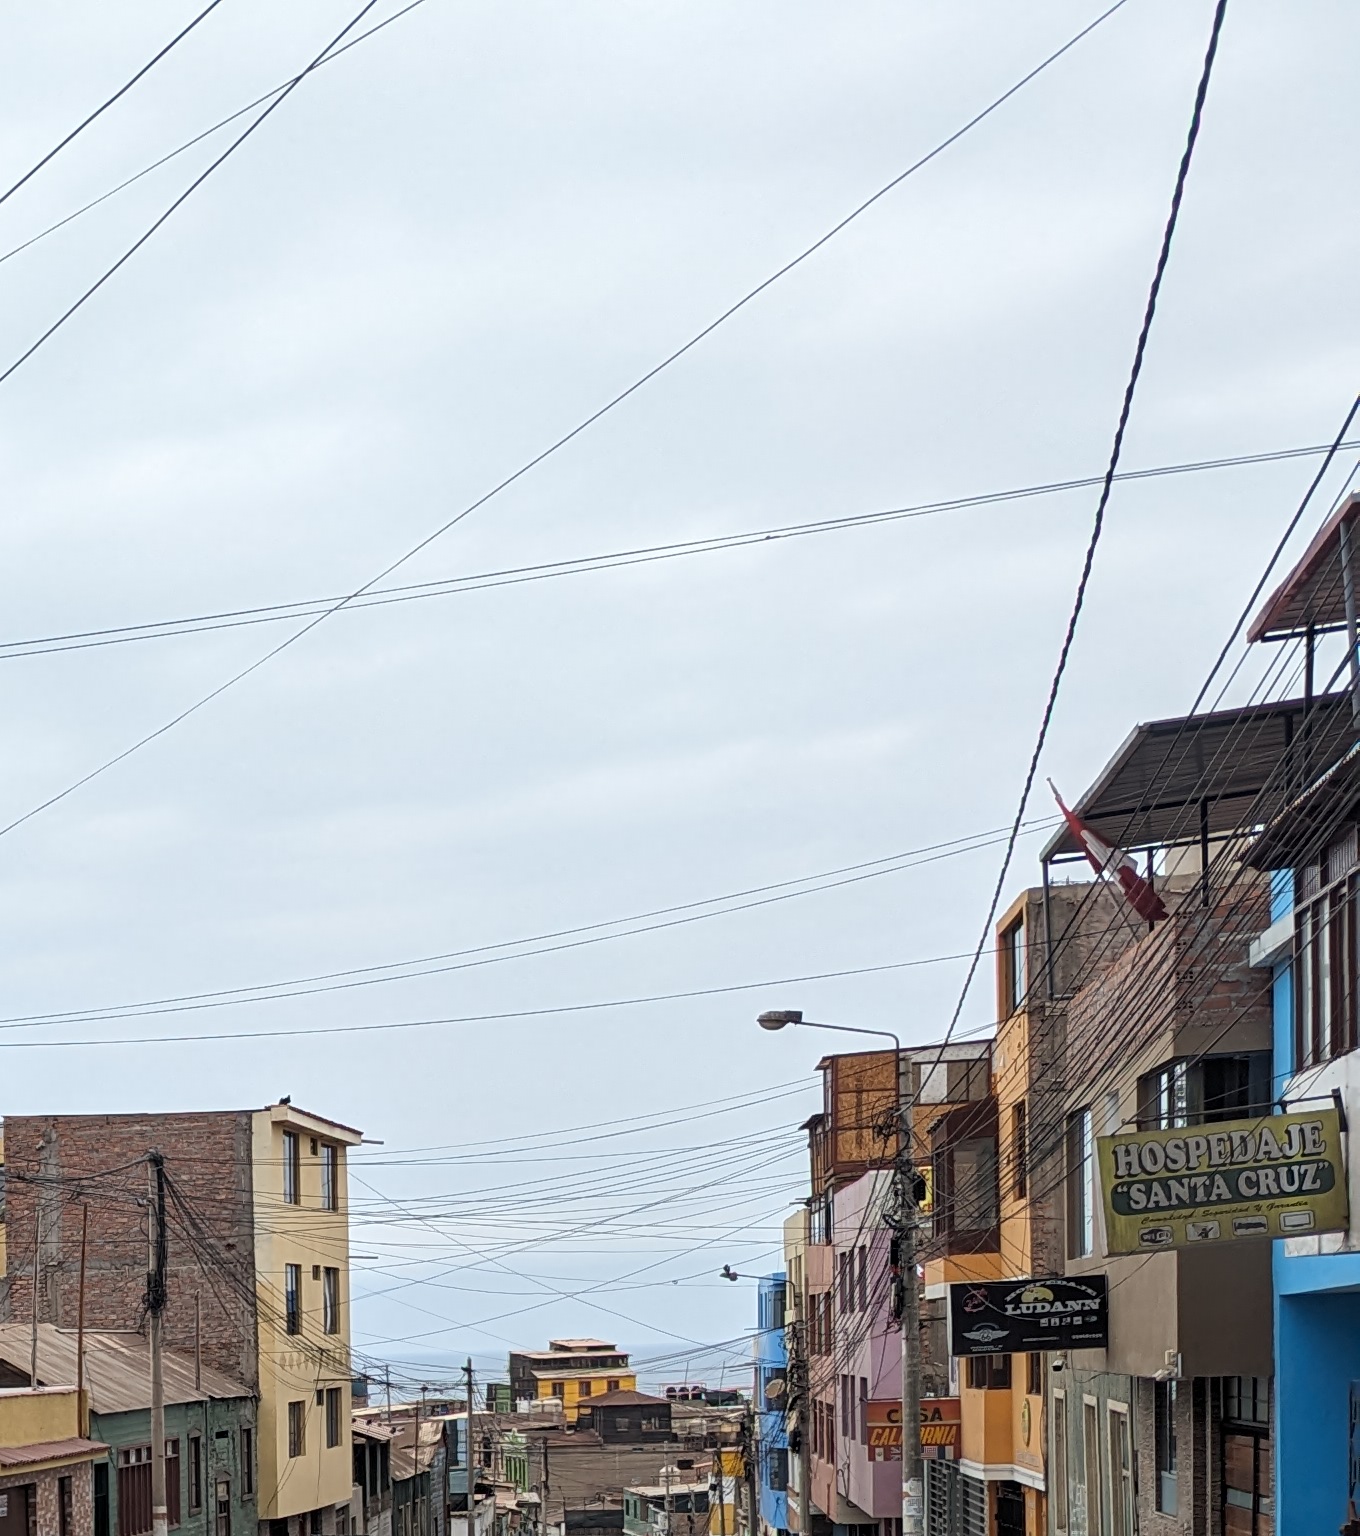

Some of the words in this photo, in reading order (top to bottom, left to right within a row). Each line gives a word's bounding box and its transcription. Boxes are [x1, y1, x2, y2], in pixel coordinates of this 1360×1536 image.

[1113, 1120, 1326, 1179] HOSPEDAJE
[1004, 1279, 1098, 1302] HOSPEDAJE
[1004, 1298, 1101, 1315] LUDANN
[886, 1406, 944, 1424] CSA
[870, 1425, 957, 1446] CALRNIA
